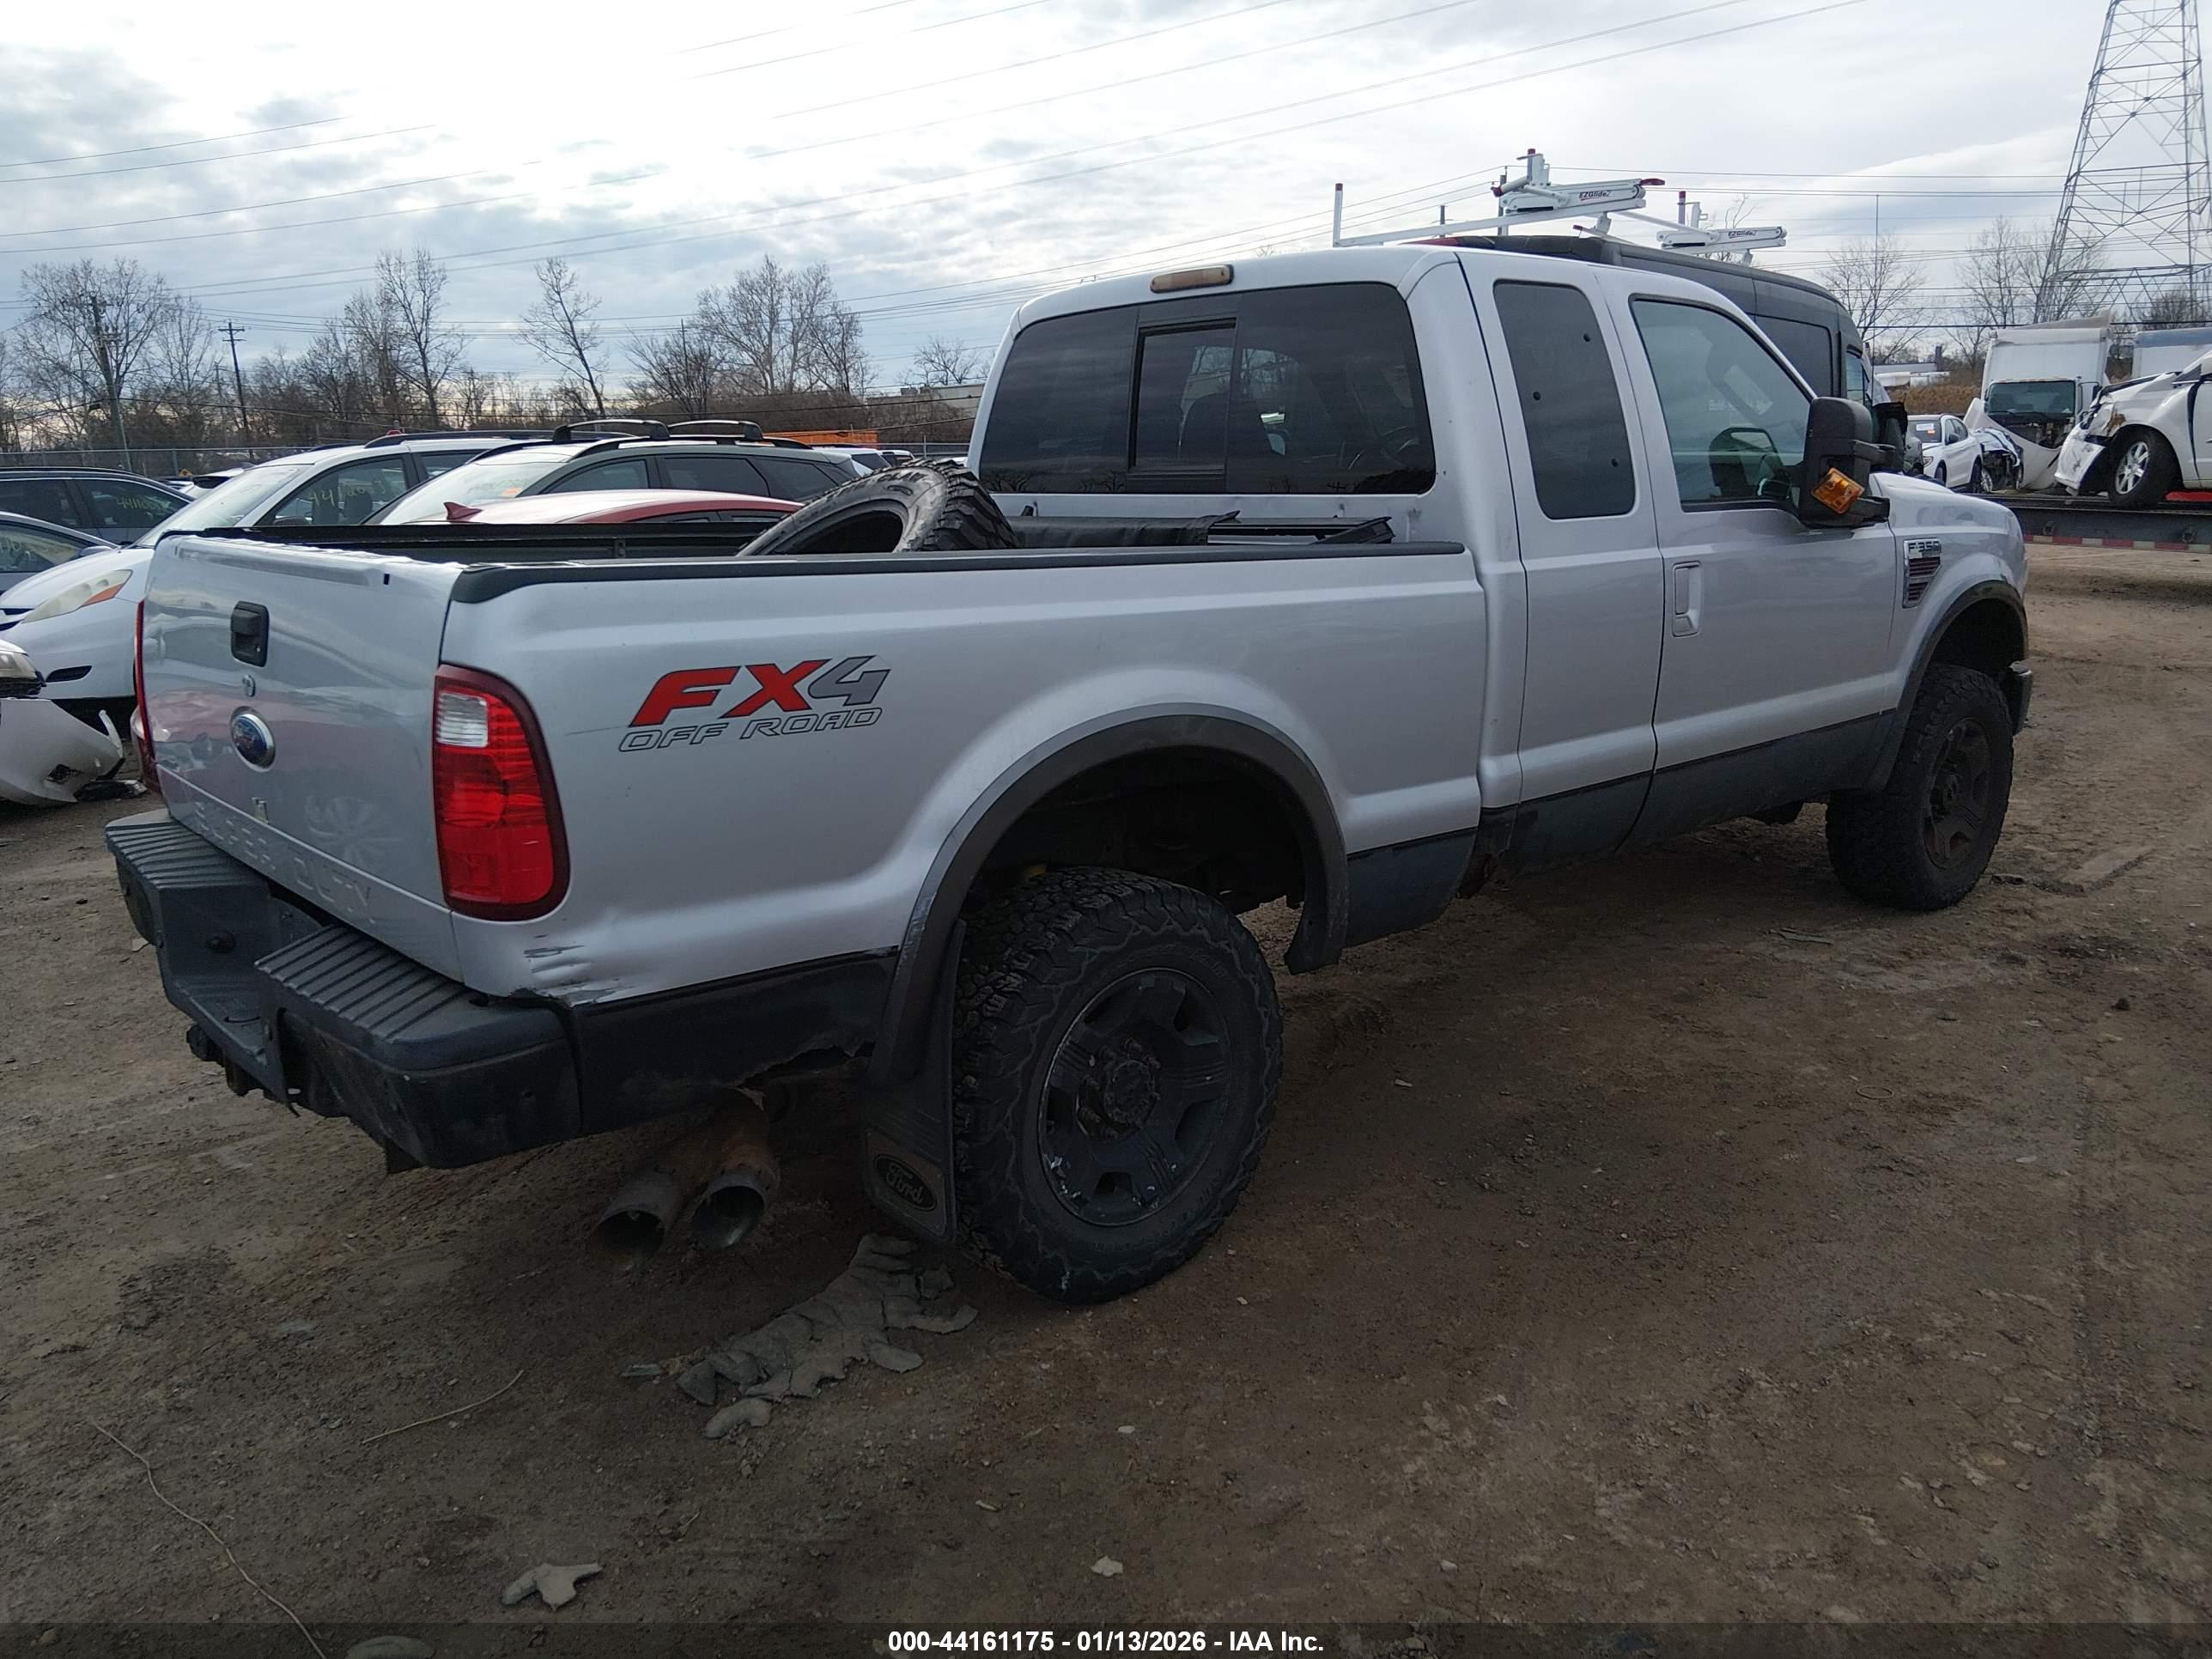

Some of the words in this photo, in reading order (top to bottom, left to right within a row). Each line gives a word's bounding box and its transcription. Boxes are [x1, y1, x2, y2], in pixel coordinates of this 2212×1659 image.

[628, 655, 891, 727] FX4
[618, 722, 729, 752] OFF
[739, 708, 883, 739] ROAD
[884, 1160, 927, 1205] Ford
